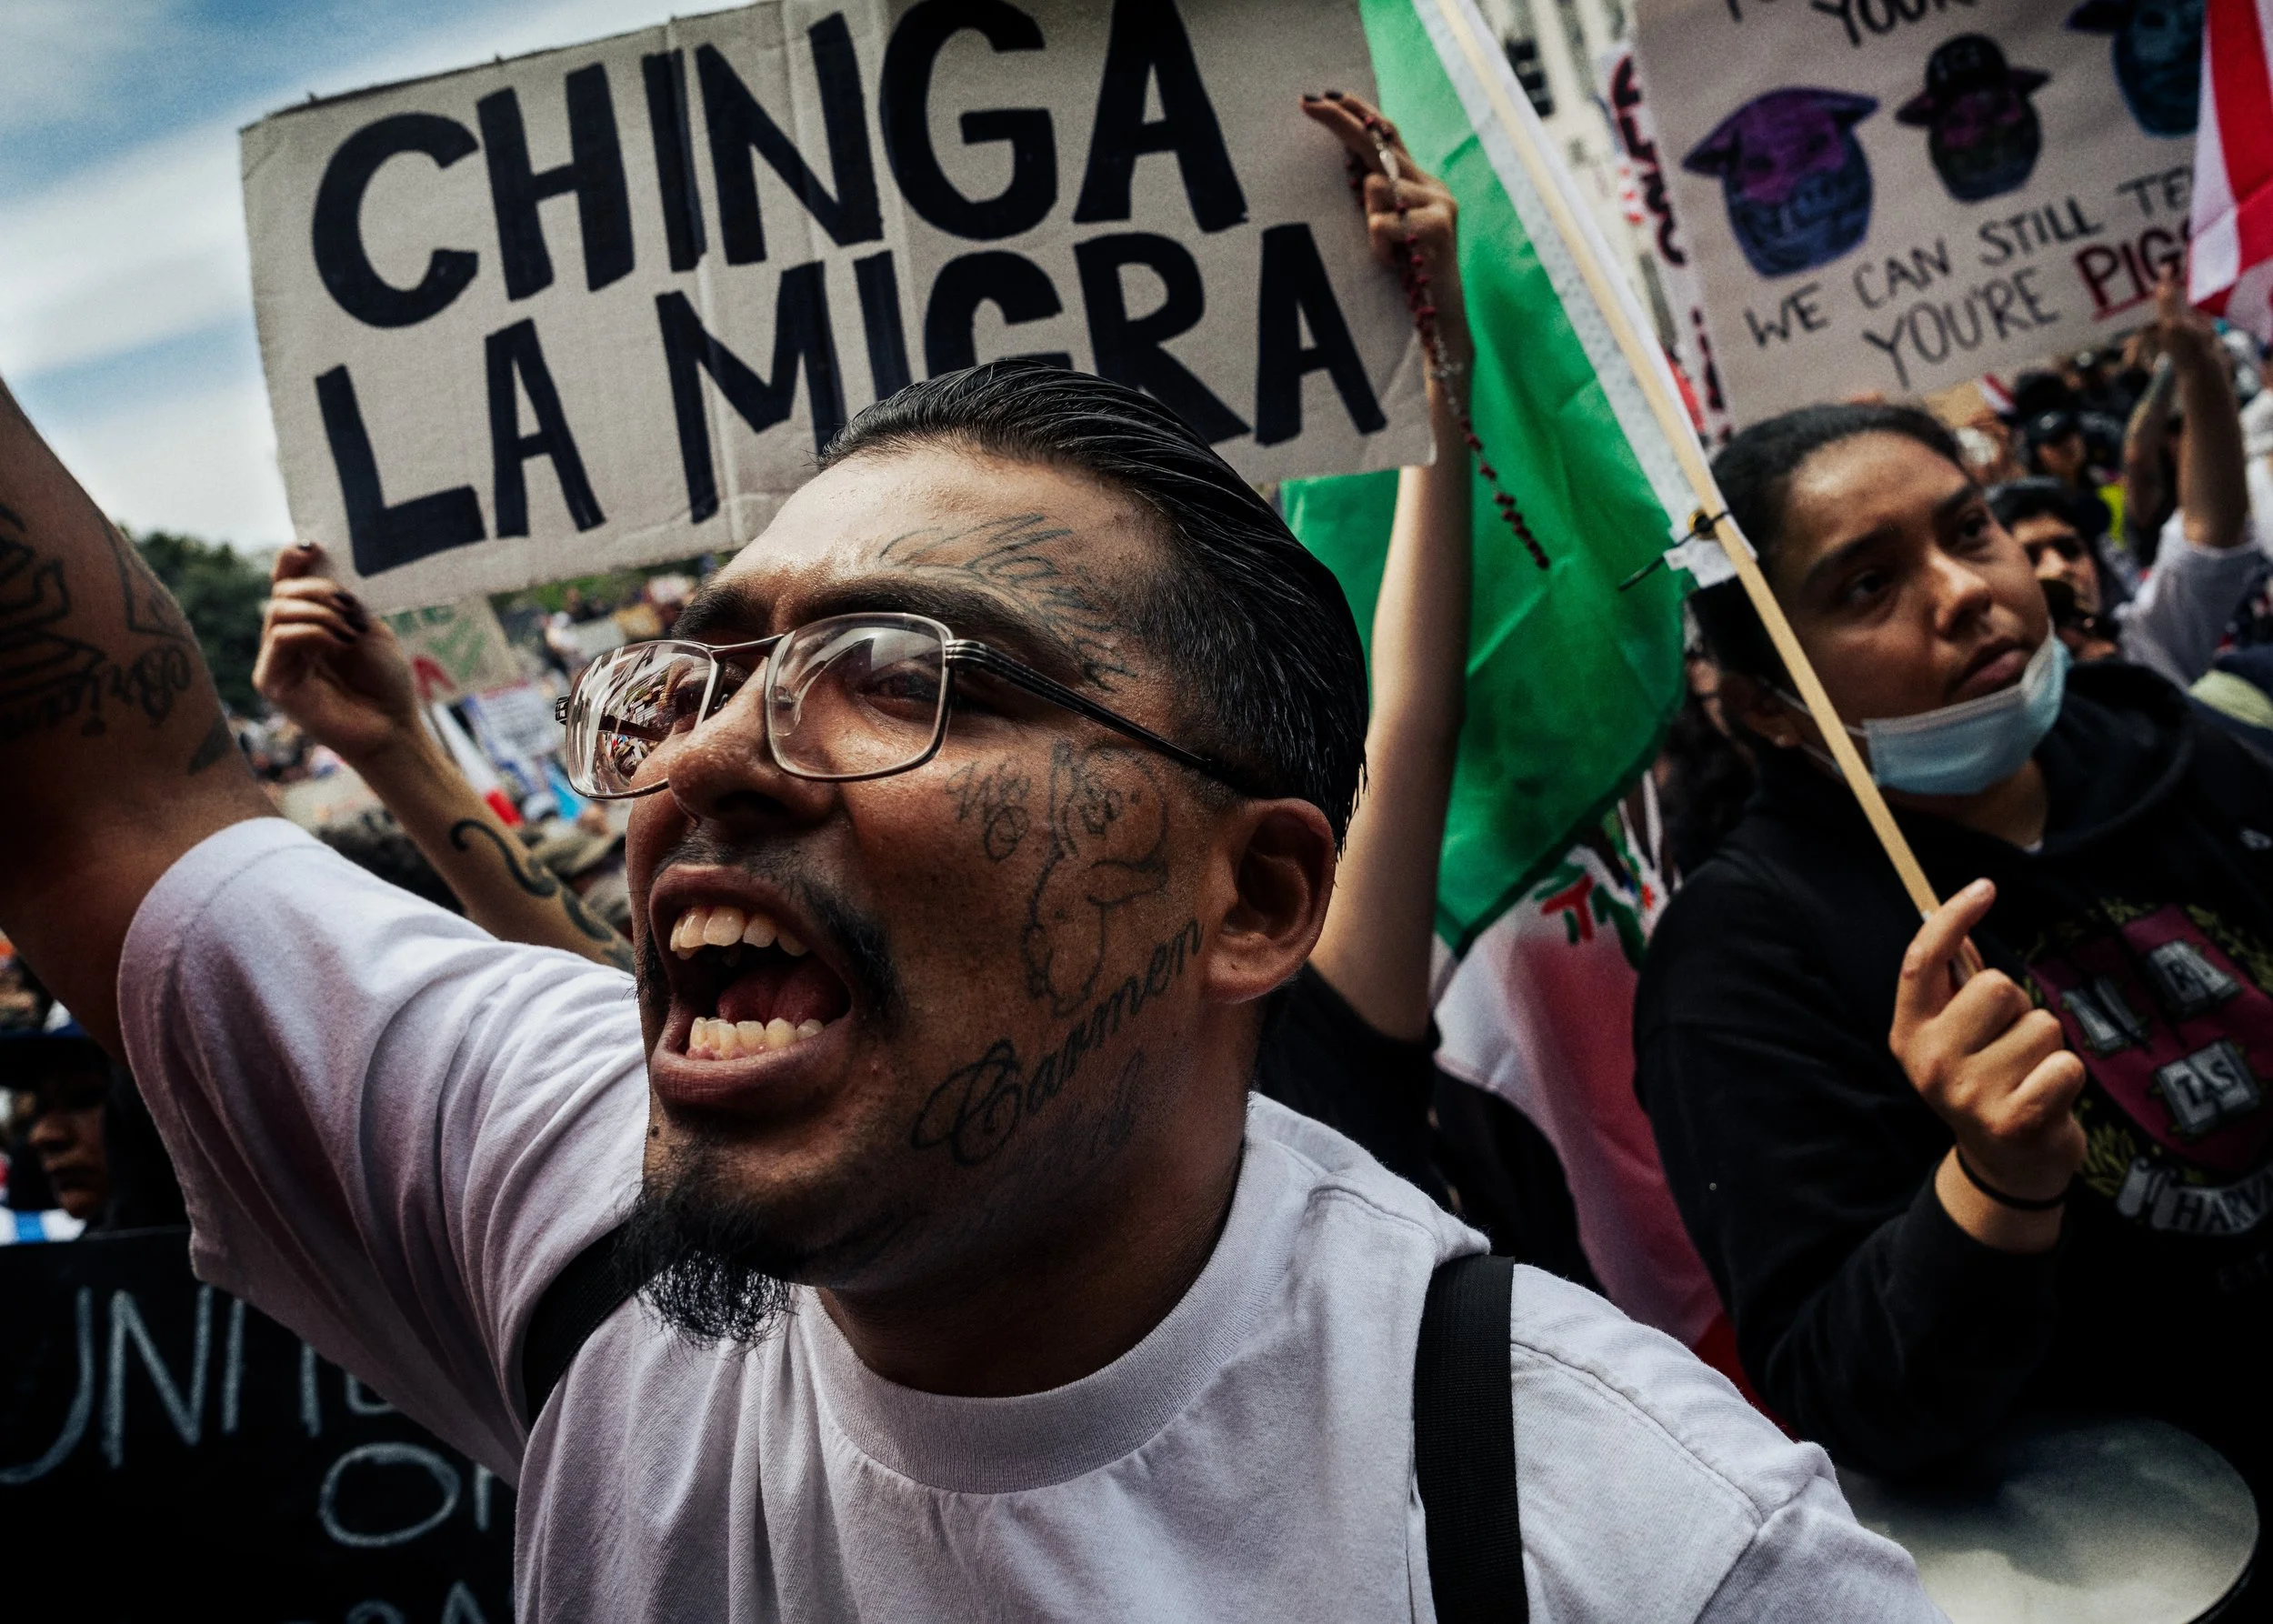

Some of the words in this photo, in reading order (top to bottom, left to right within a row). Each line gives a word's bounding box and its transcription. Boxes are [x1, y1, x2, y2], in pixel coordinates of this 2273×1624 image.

[312, 0, 1249, 329] CHINGA
[1744, 283, 1830, 350] WE
[1852, 239, 1952, 311] CAN
[1978, 194, 2104, 270] STILL
[1863, 267, 2061, 389] YOU'RE
[2074, 216, 2190, 309] PIG
[315, 317, 605, 577] LA
[656, 223, 1387, 525] MIGRA
[911, 917, 1205, 1168] Carmen
[2169, 1167, 2273, 1231] HARV
